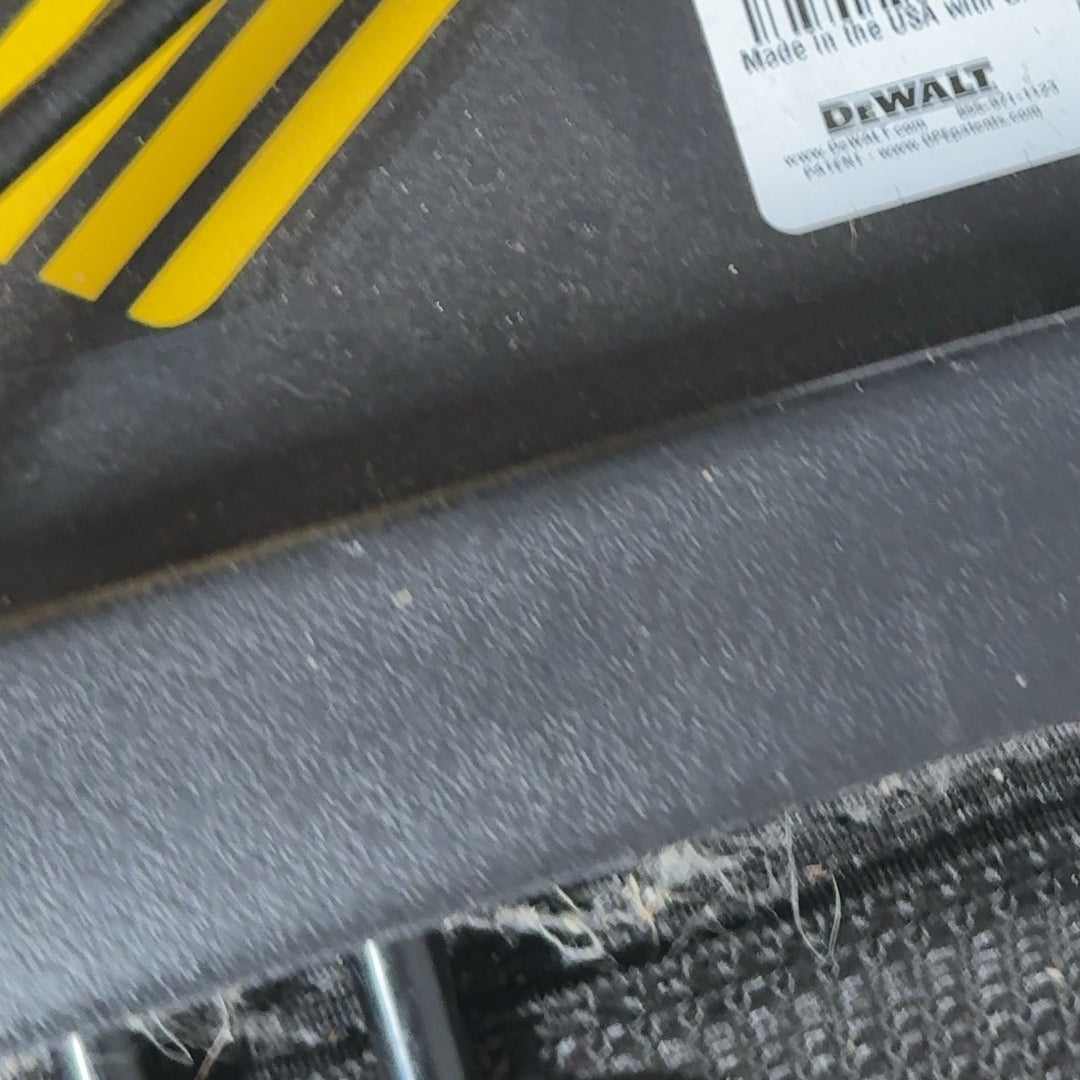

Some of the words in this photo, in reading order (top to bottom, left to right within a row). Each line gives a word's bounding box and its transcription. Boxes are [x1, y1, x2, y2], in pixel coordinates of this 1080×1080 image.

[739, 39, 808, 75] Made
[814, 29, 838, 55] in
[842, 18, 883, 48] the
